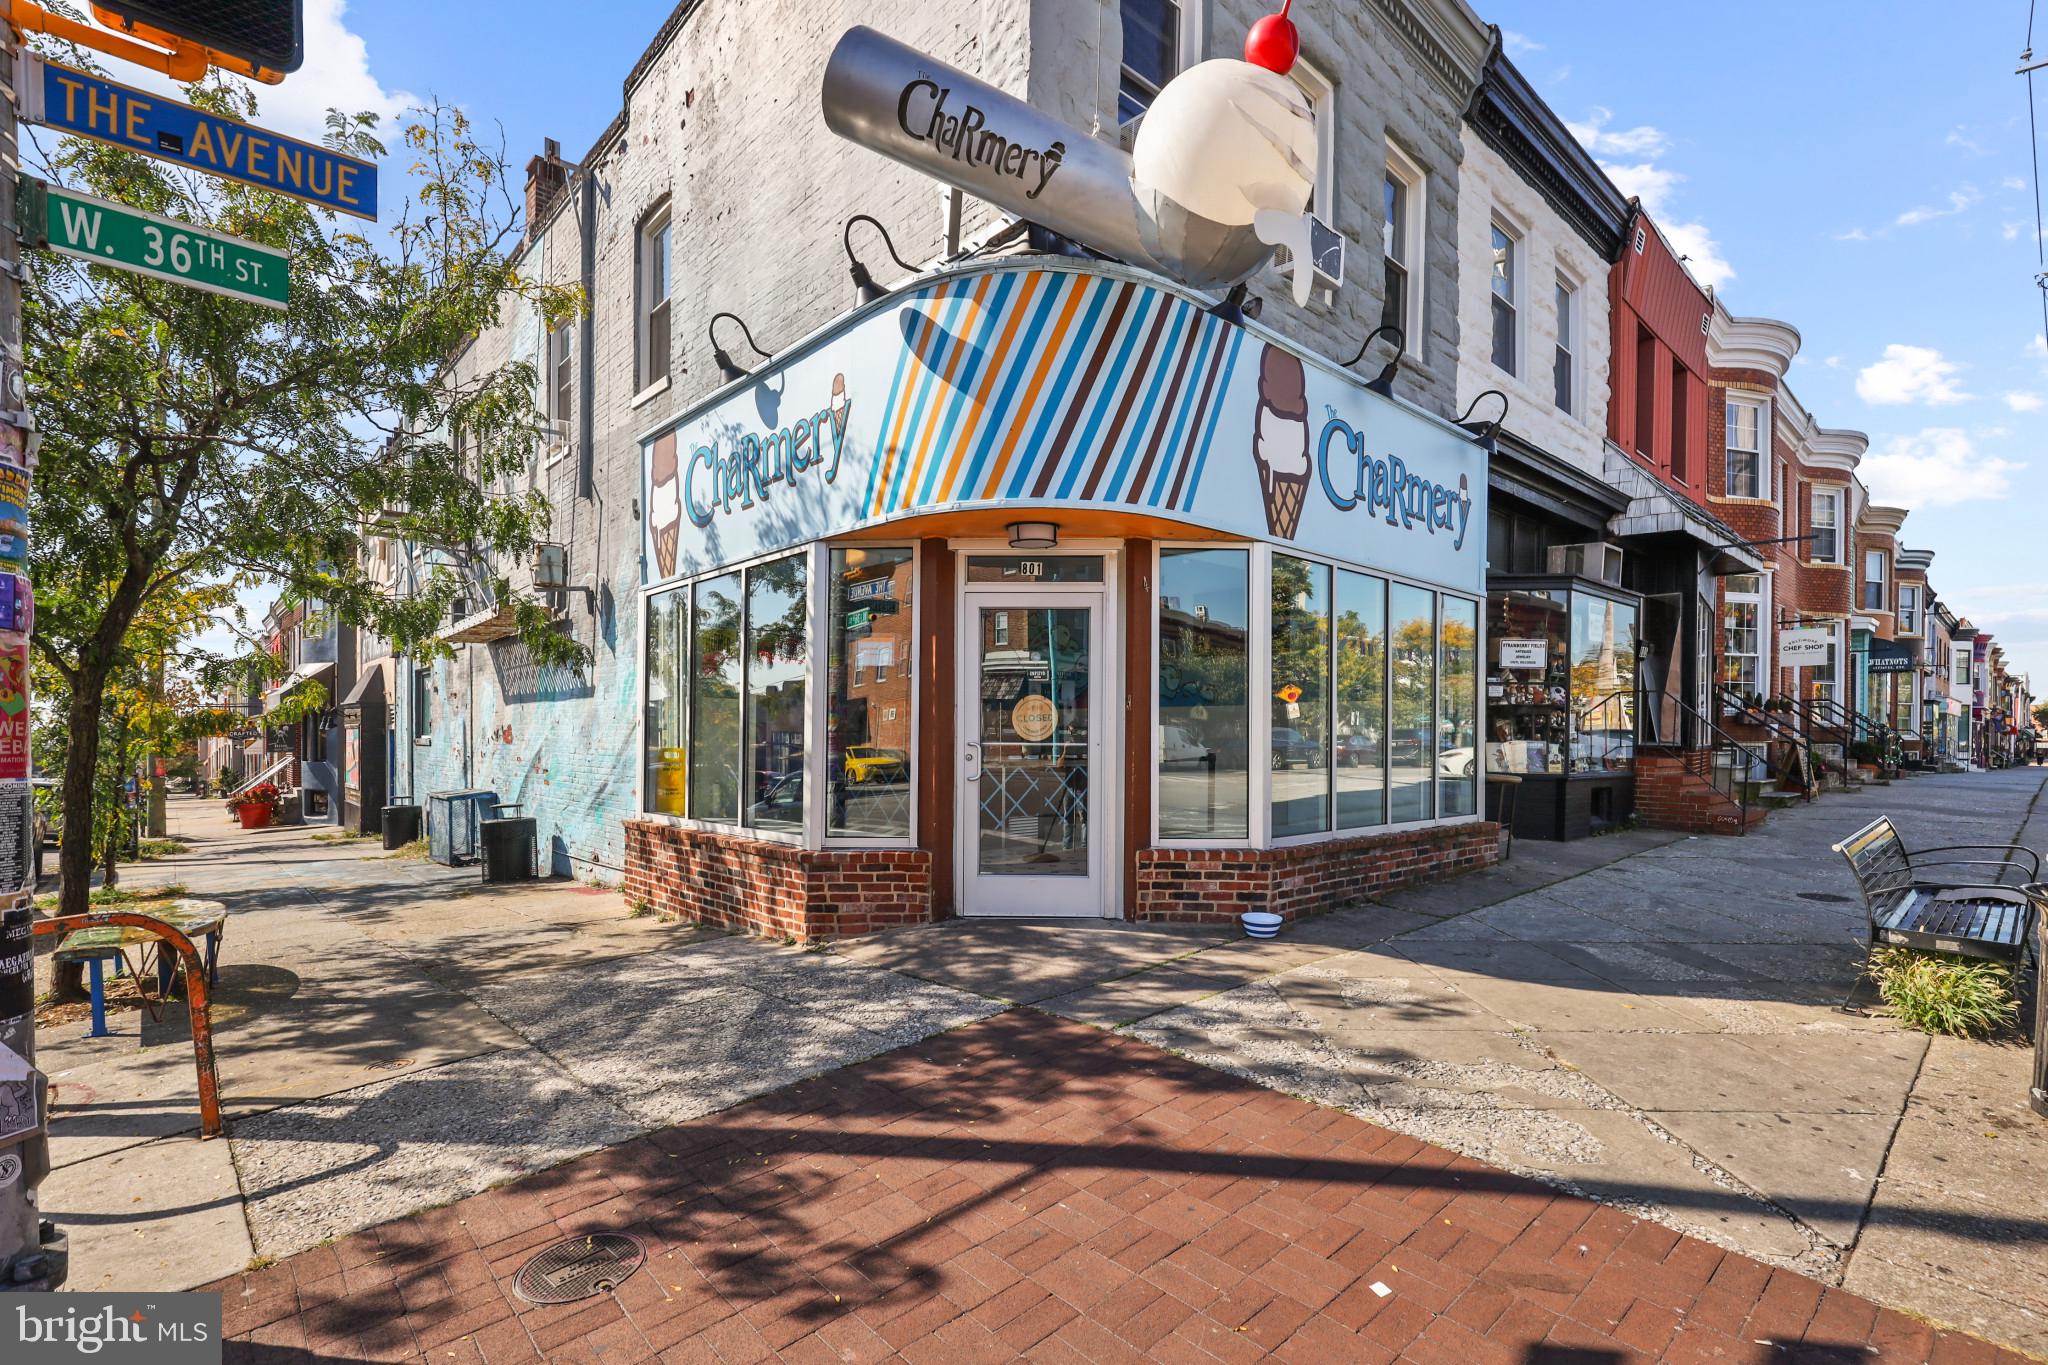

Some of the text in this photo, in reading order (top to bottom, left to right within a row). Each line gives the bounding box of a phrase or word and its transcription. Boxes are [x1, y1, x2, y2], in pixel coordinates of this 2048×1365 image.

[57, 77, 359, 205] THE AVENUE
[59, 201, 268, 288] W. 36TH ST.
[1021, 562, 1042, 576] 801
[1868, 657, 1909, 665] WHATNOTS
[1015, 713, 1053, 723] CLOSED
